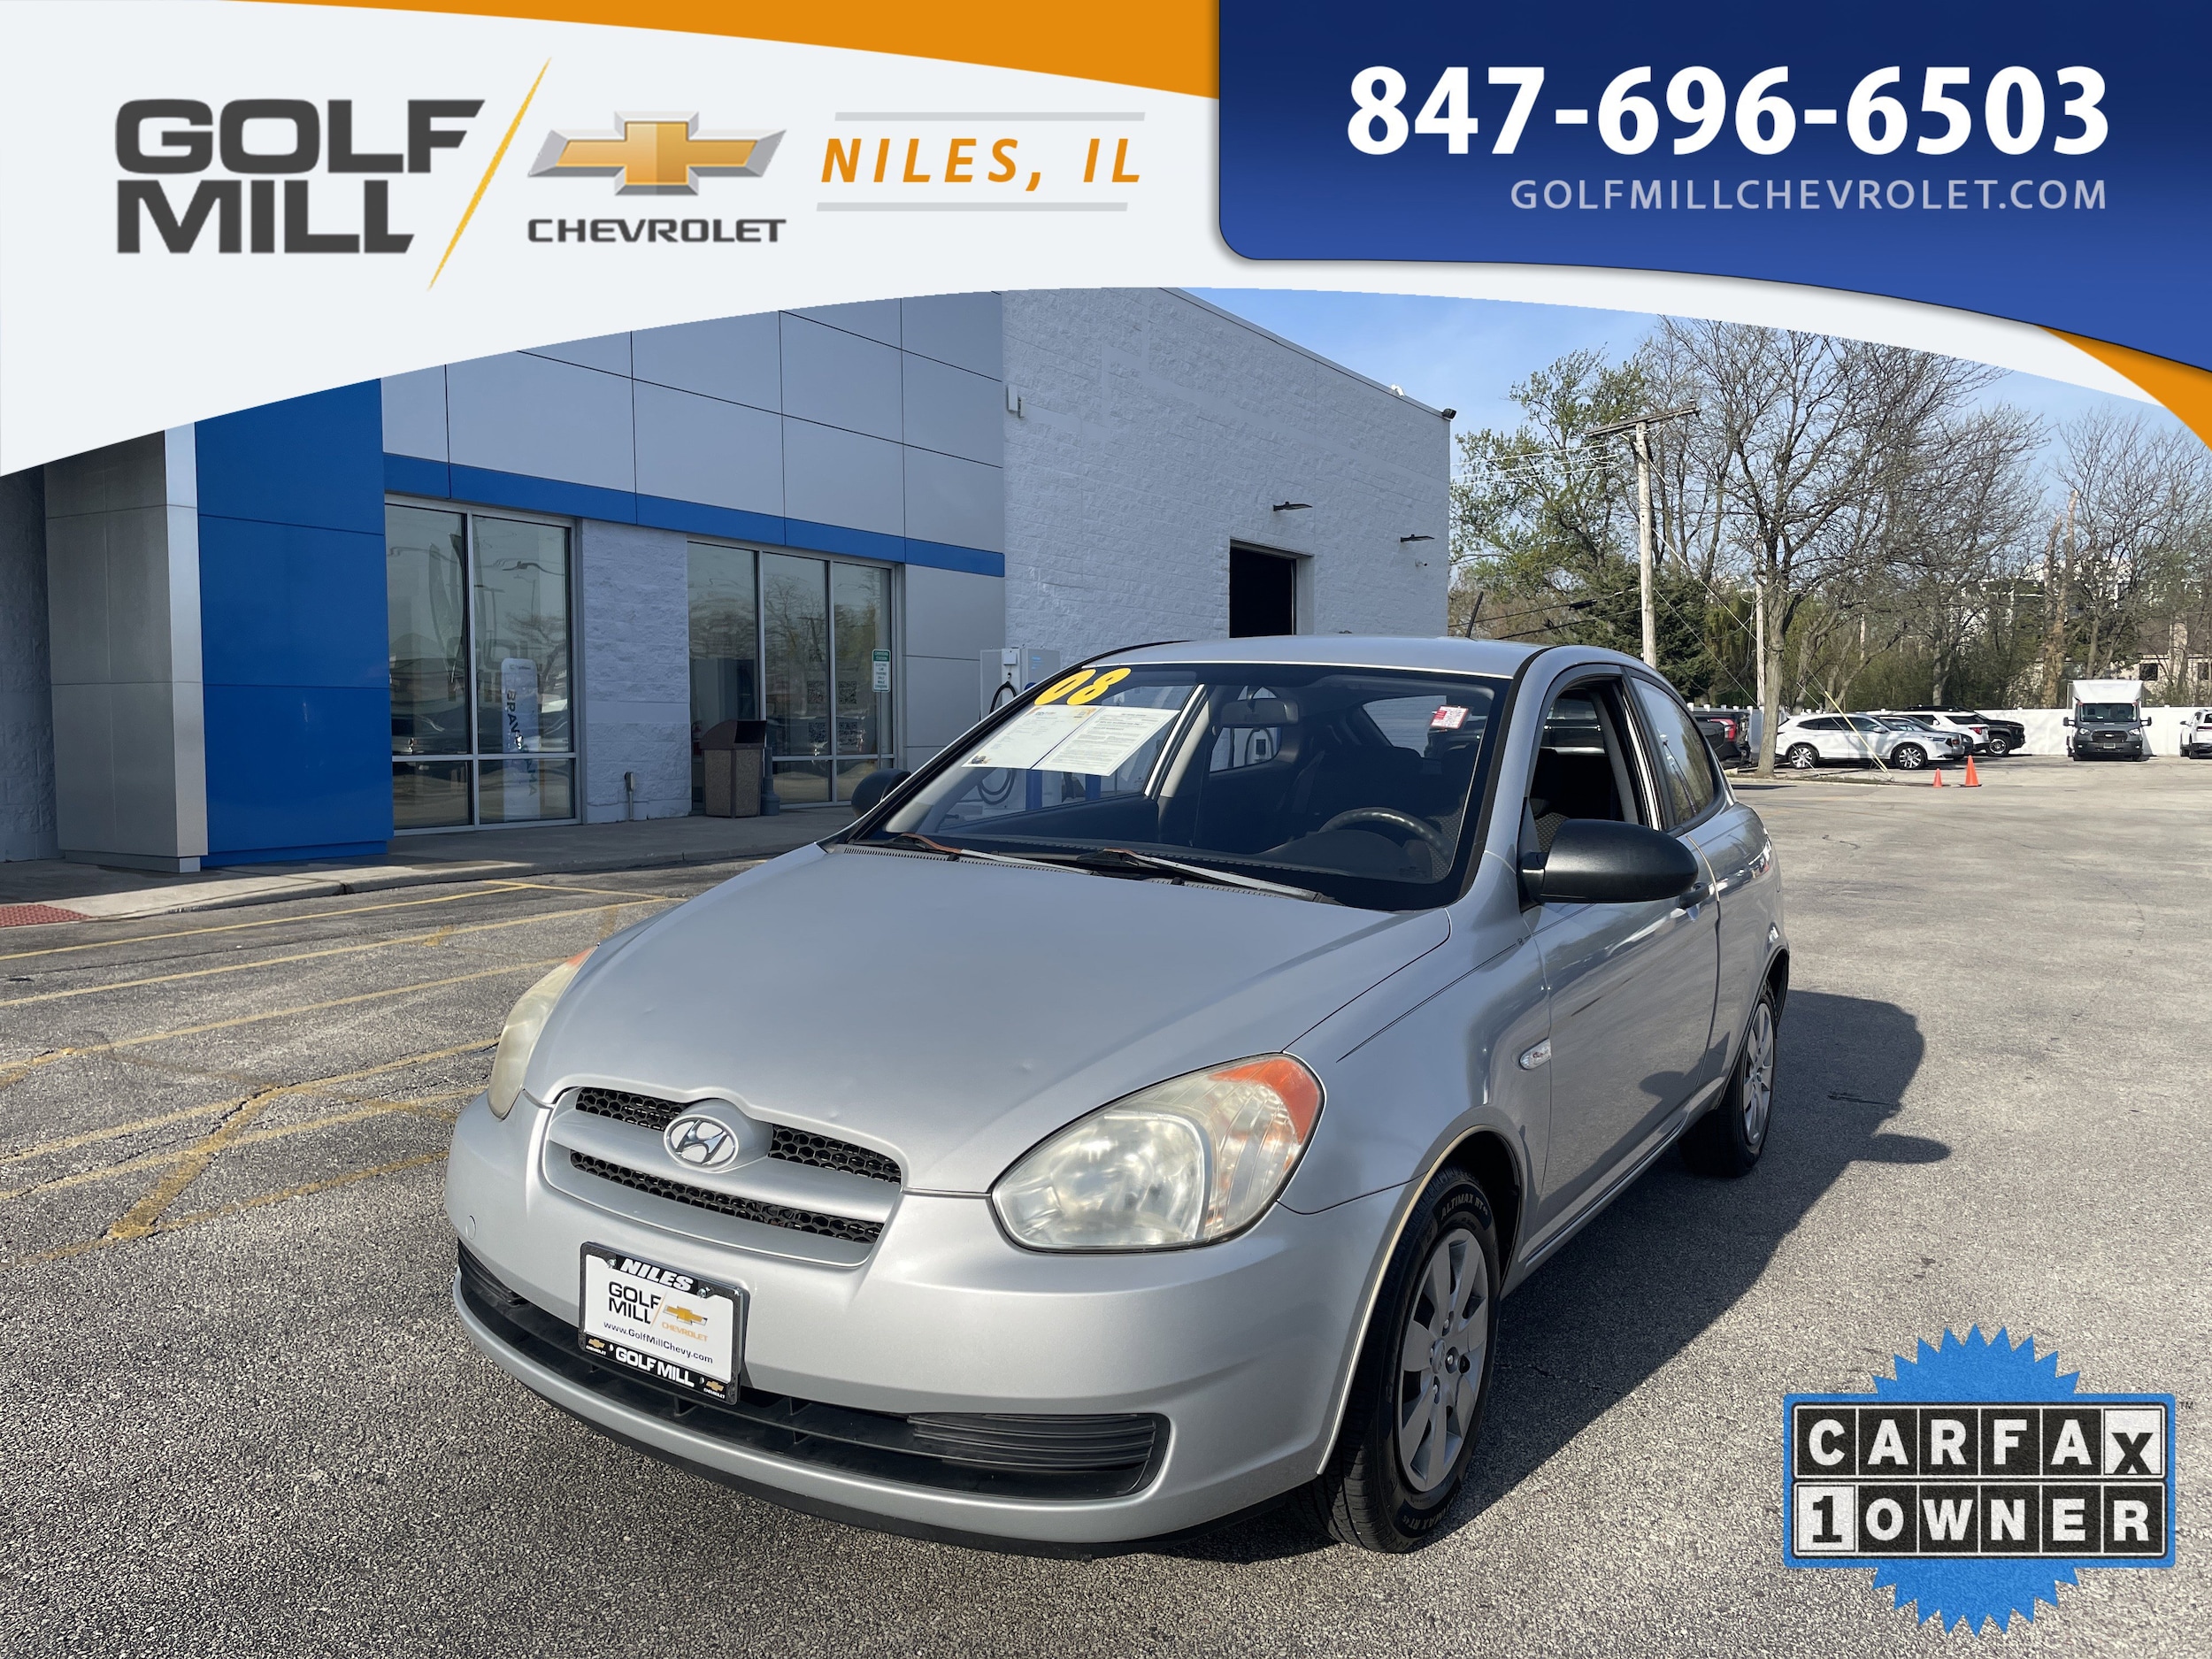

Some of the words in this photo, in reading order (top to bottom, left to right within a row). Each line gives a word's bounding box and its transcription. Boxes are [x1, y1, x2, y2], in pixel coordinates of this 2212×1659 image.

[1034, 668, 1132, 705] 08
[620, 1258, 693, 1291] NILES
[609, 1282, 661, 1310] GOLF
[609, 1298, 651, 1325] MILL
[603, 1321, 713, 1363] www.GolfMillChevy.com
[662, 1322, 708, 1341] CHEVROLET
[616, 1347, 657, 1371] GOLF
[657, 1362, 695, 1387] MILL
